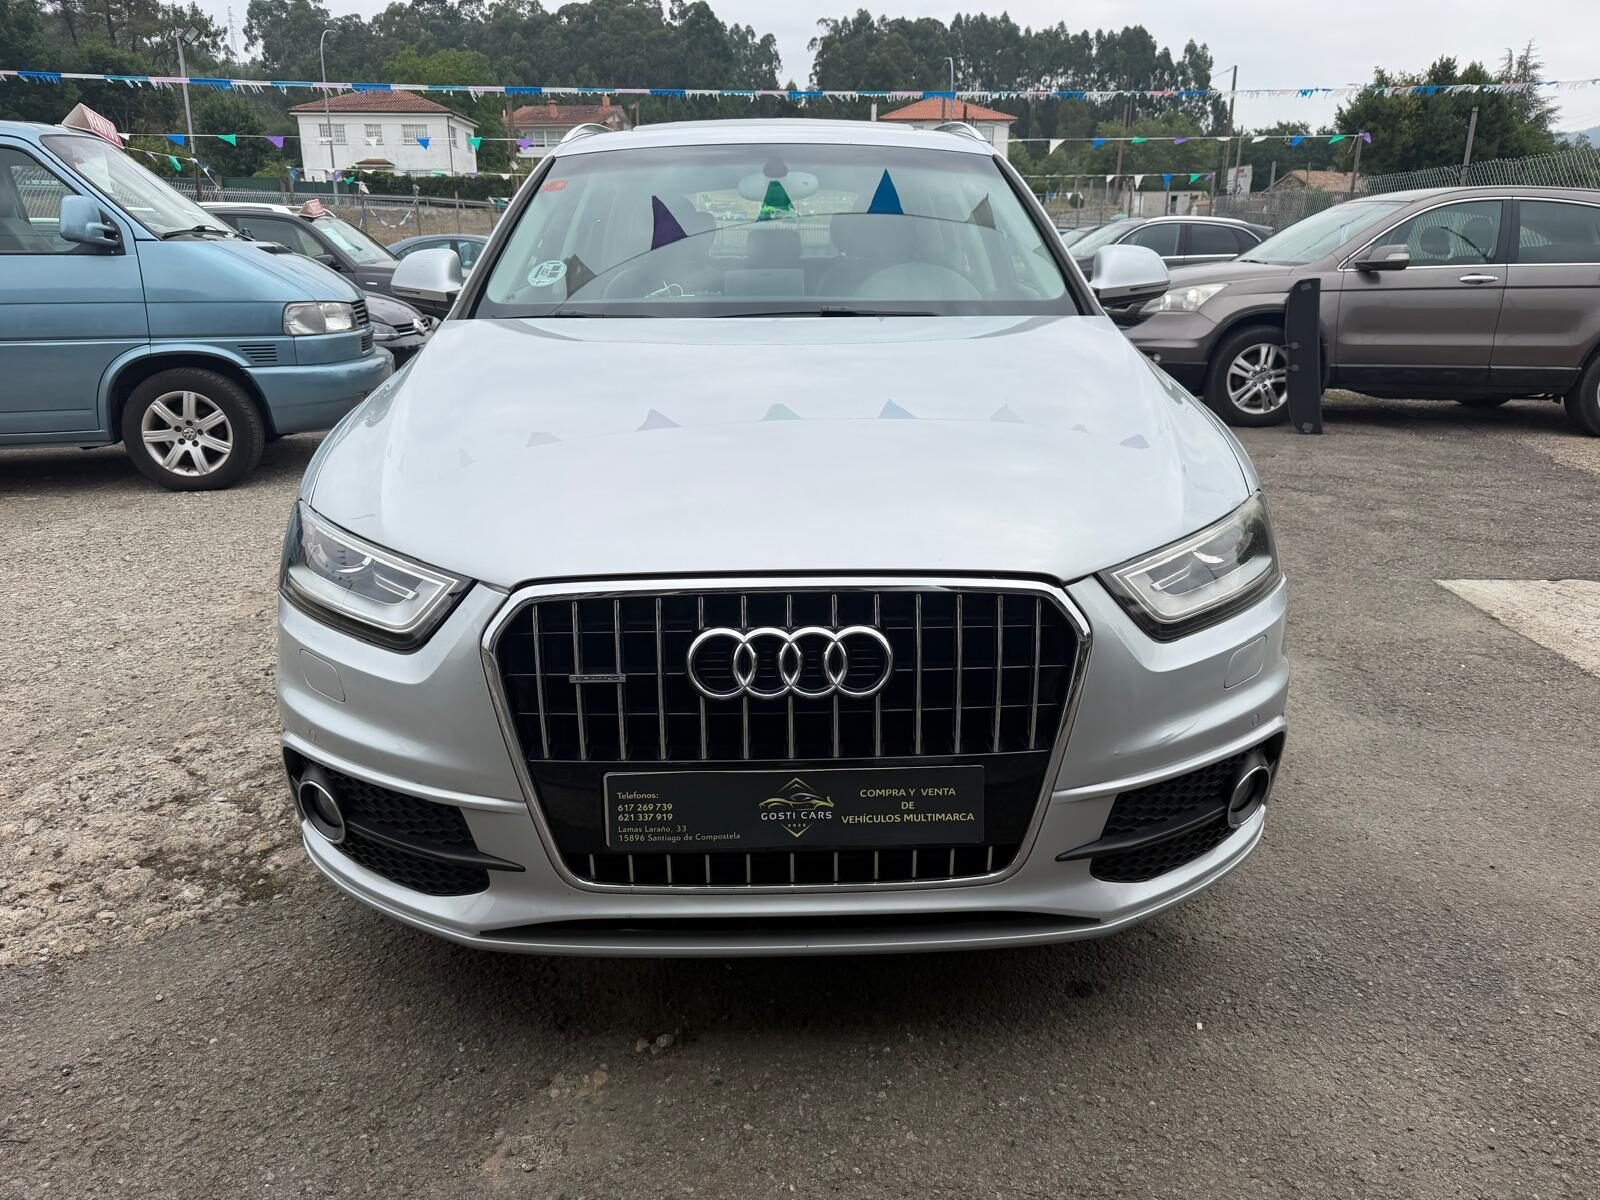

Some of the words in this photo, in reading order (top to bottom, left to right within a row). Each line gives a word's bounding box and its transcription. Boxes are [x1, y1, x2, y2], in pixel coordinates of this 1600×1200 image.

[860, 788, 906, 798] COMPRA
[908, 788, 916, 797] Y
[920, 787, 956, 797] VENTA
[617, 803, 634, 812] 617
[637, 803, 654, 812] 269
[656, 803, 673, 811] 739
[901, 801, 915, 810] DE
[618, 813, 634, 822] 621
[637, 813, 654, 821] 337
[656, 813, 673, 821] 919
[760, 811, 796, 821] GOSTI
[800, 811, 833, 820] CARS
[841, 813, 901, 824] VEHÍCULOS
[903, 812, 975, 823] MULTIMARCA
[618, 825, 642, 833] Lamas
[676, 825, 687, 833] 33
[618, 834, 645, 842] 15896
[647, 834, 681, 843] Santiago
[684, 833, 693, 841] de
[695, 832, 741, 842] Compostela
